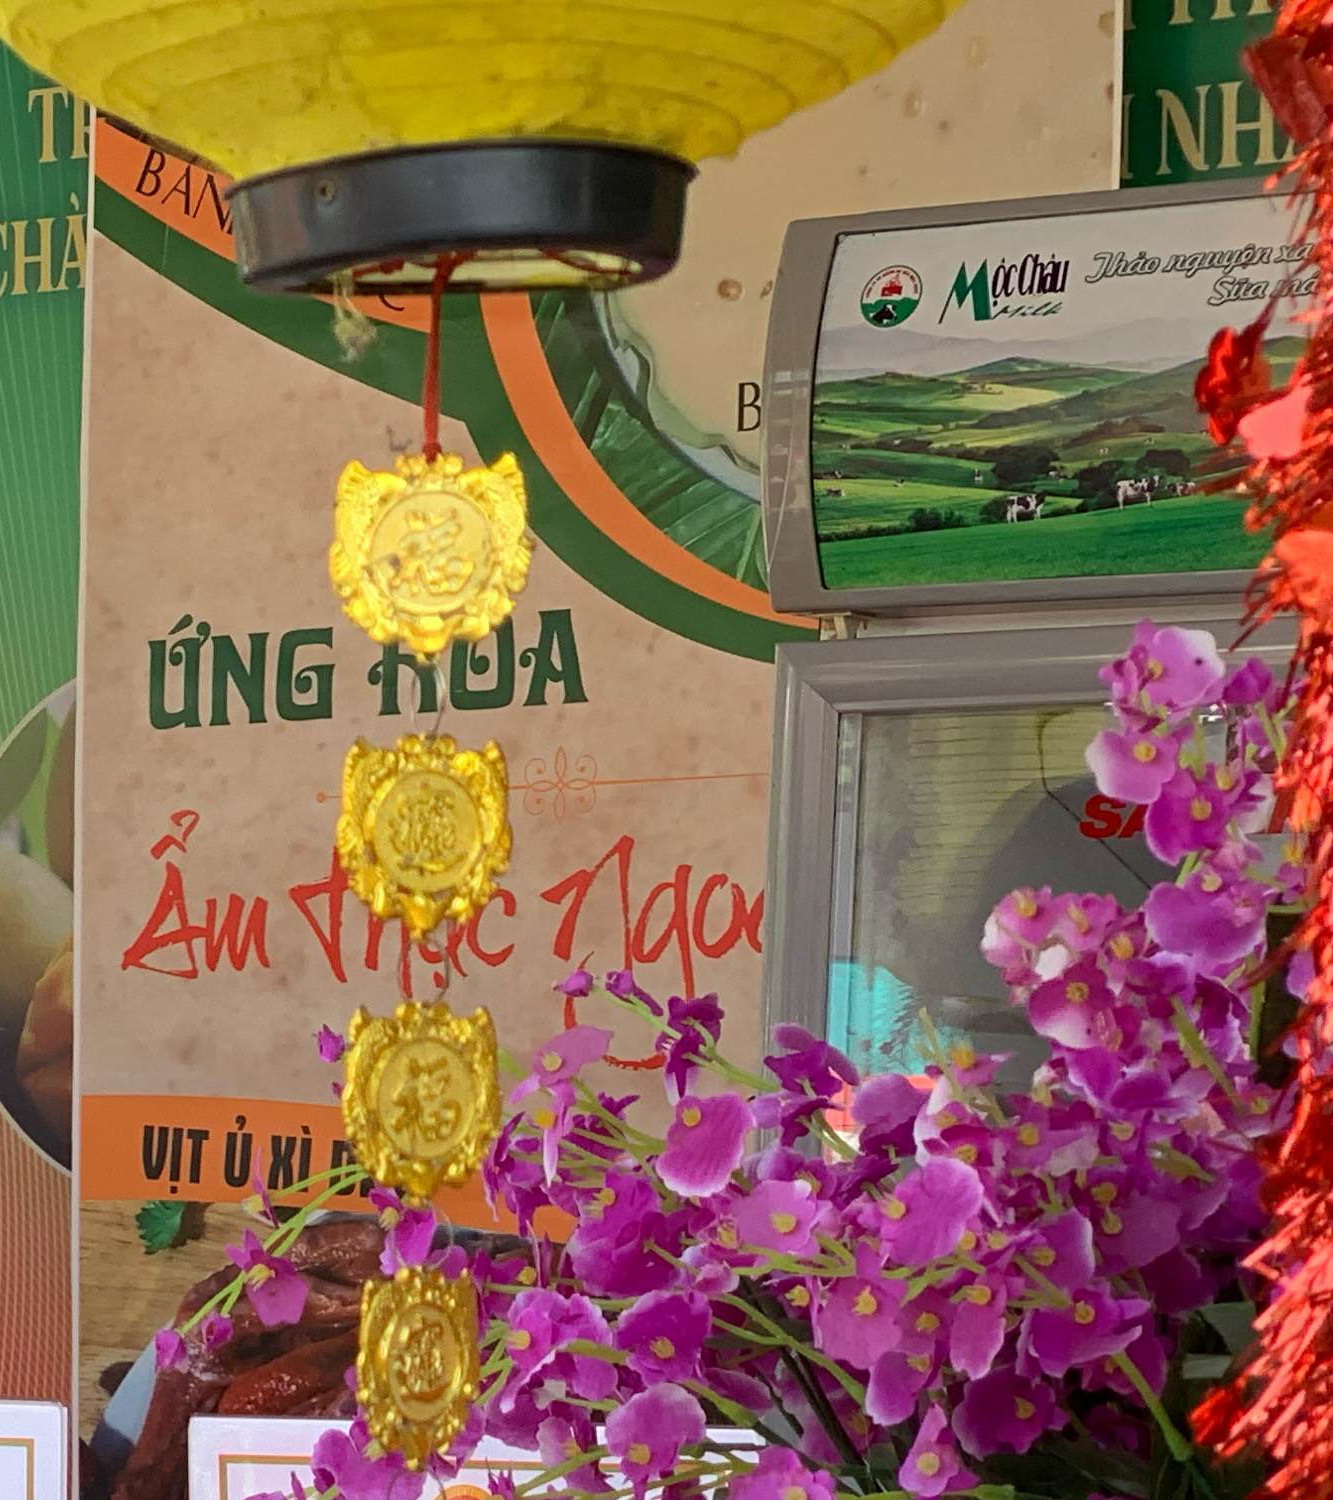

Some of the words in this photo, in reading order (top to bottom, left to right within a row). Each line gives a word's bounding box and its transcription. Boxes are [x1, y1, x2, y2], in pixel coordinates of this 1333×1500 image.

[938, 257, 1016, 324] Mộc
[1018, 253, 1071, 298] Châu
[147, 614, 336, 730] ỨNG
[121, 809, 271, 980] Ẩm
[142, 1125, 210, 1194] VỊT
[224, 1114, 253, 1188] Ủ
[267, 1125, 312, 1192] XÌ
